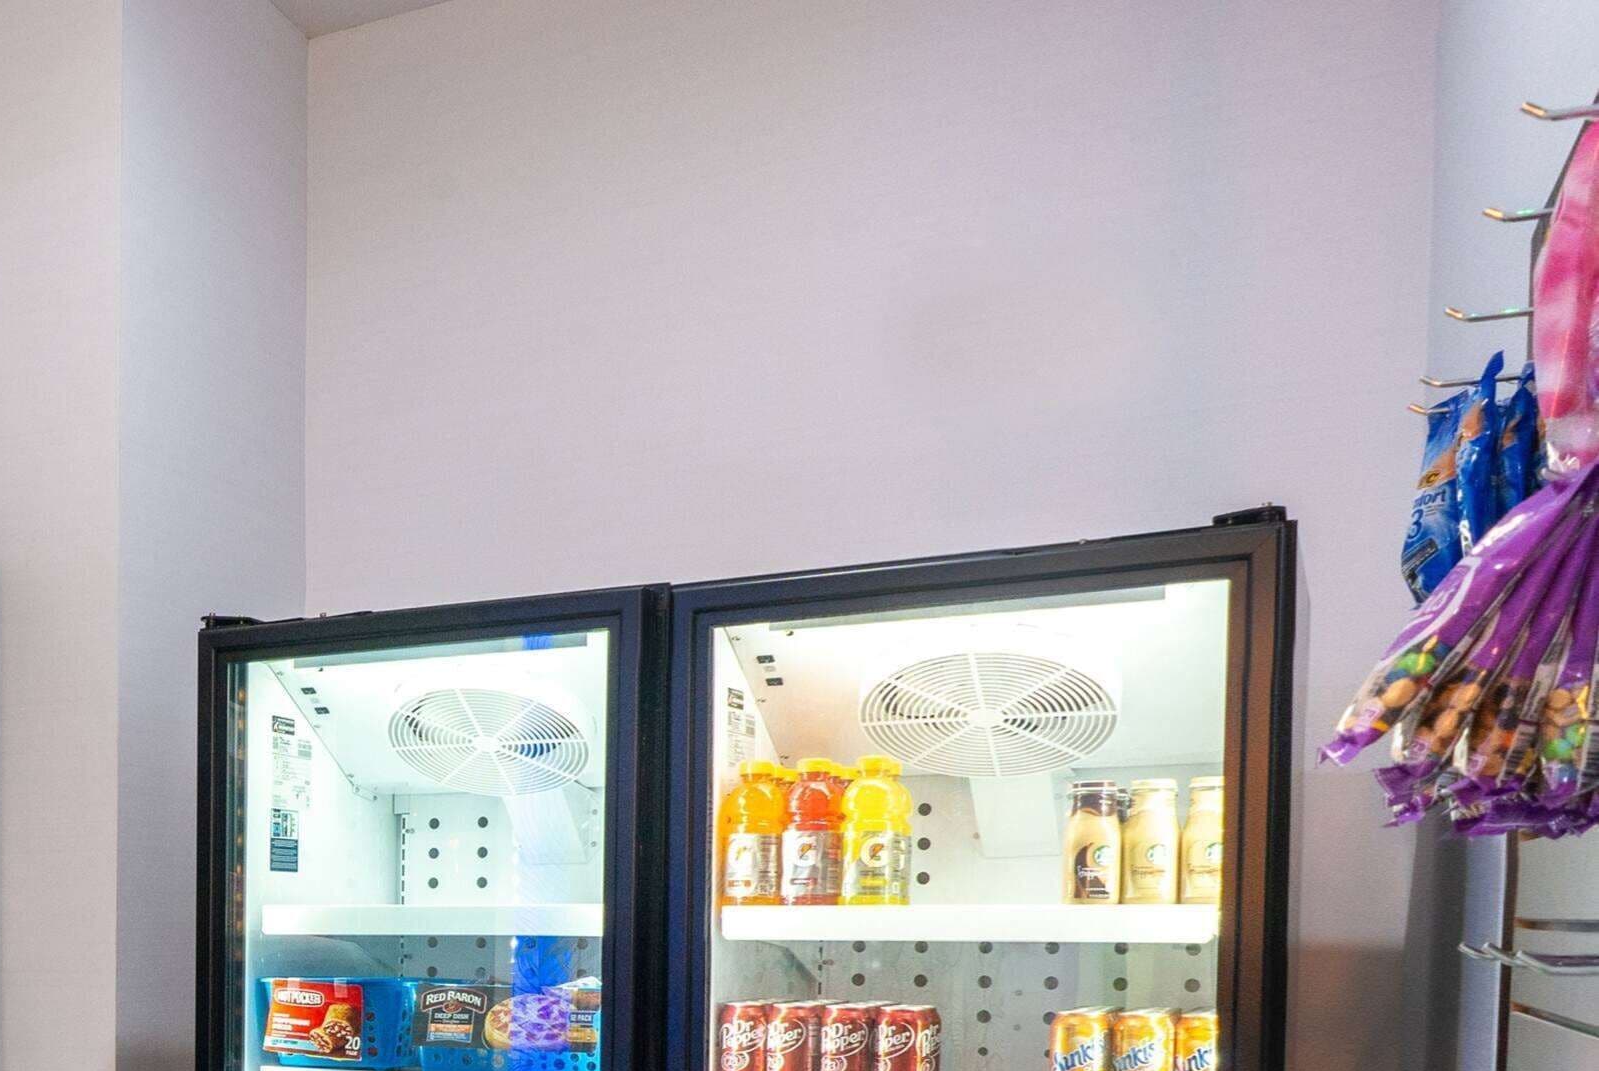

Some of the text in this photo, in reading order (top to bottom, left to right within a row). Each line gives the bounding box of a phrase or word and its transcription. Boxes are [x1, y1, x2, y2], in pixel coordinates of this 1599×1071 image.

[1408, 508, 1424, 540] 3
[426, 990, 482, 1006] RED BARON
[578, 1014, 592, 1022] PACK
[734, 1018, 753, 1032] Dr
[832, 1022, 852, 1036] Dr
[345, 1036, 361, 1050] 20
